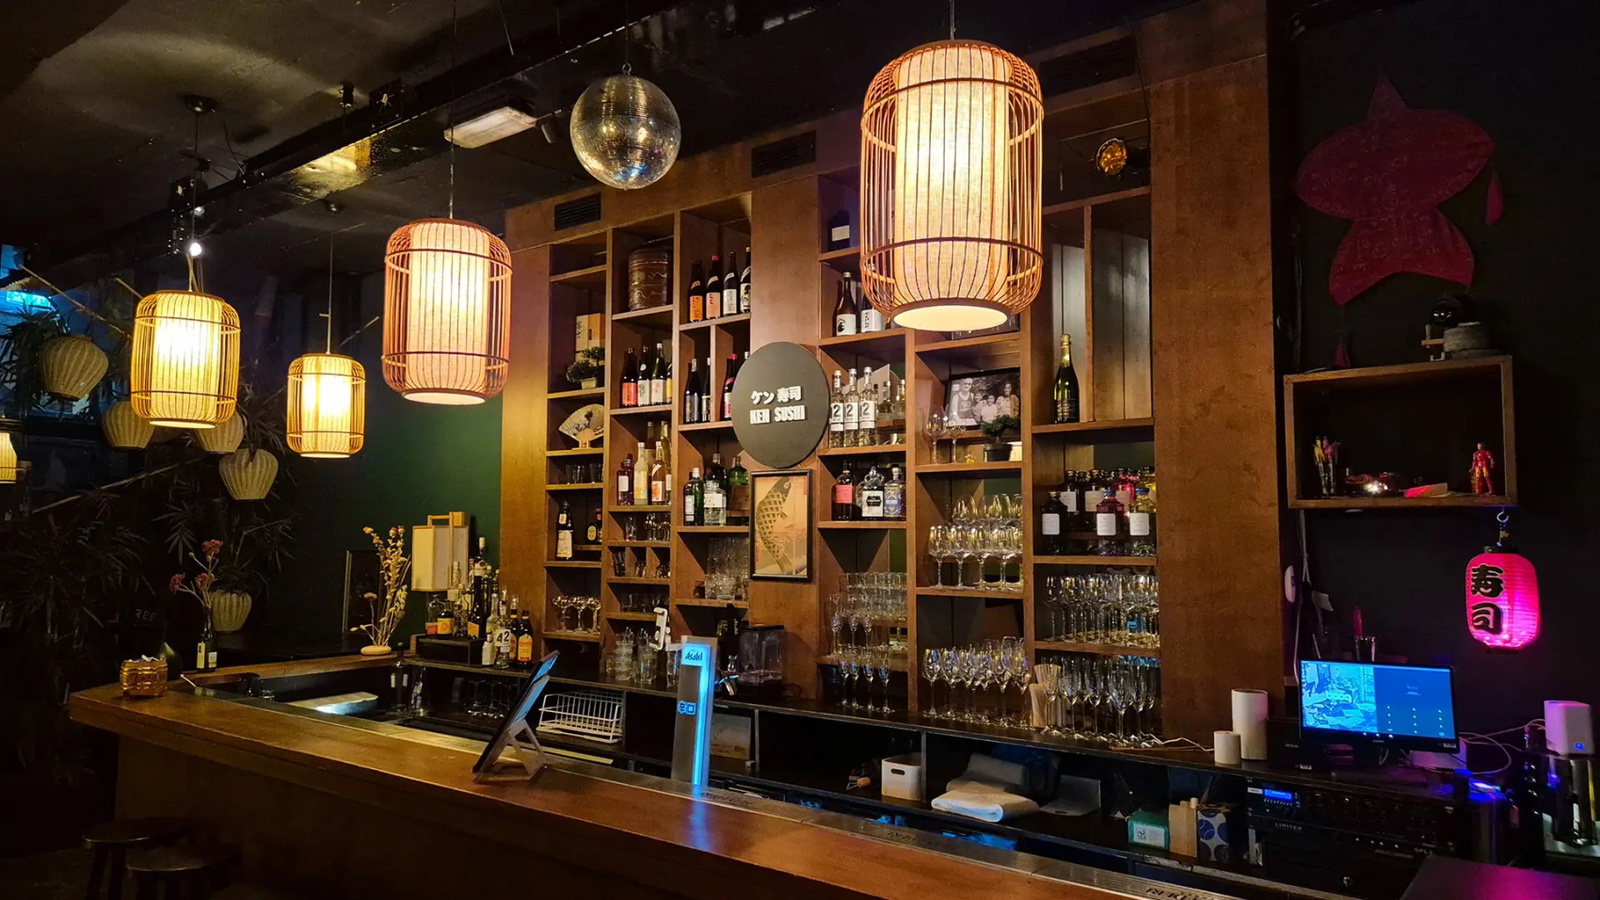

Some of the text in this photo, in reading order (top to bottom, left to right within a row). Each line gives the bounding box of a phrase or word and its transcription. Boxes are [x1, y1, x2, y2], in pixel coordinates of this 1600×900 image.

[774, 405, 805, 422] SUSHI
[1471, 564, 1506, 635] 寿司
[496, 630, 511, 644] 42
